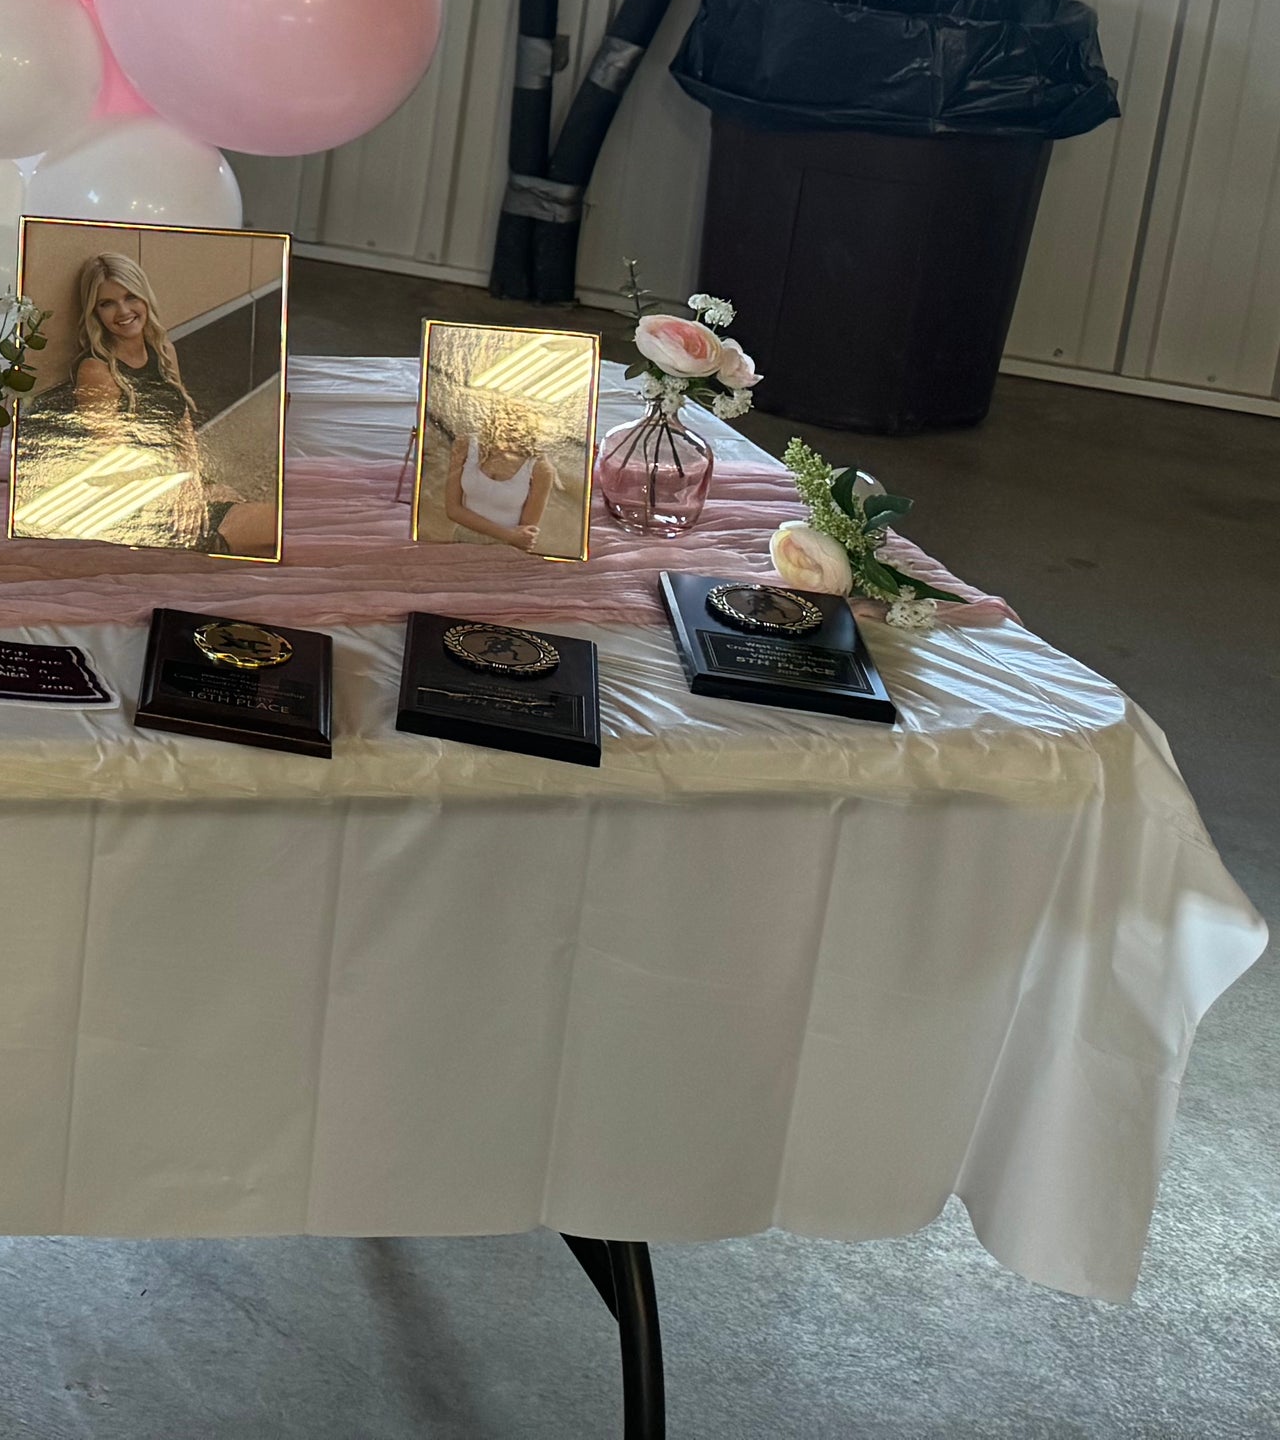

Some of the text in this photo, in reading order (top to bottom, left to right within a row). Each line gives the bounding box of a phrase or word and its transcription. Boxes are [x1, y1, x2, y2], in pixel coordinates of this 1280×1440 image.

[777, 662, 836, 677] PLACE
[190, 690, 290, 714] 16TH PLACE
